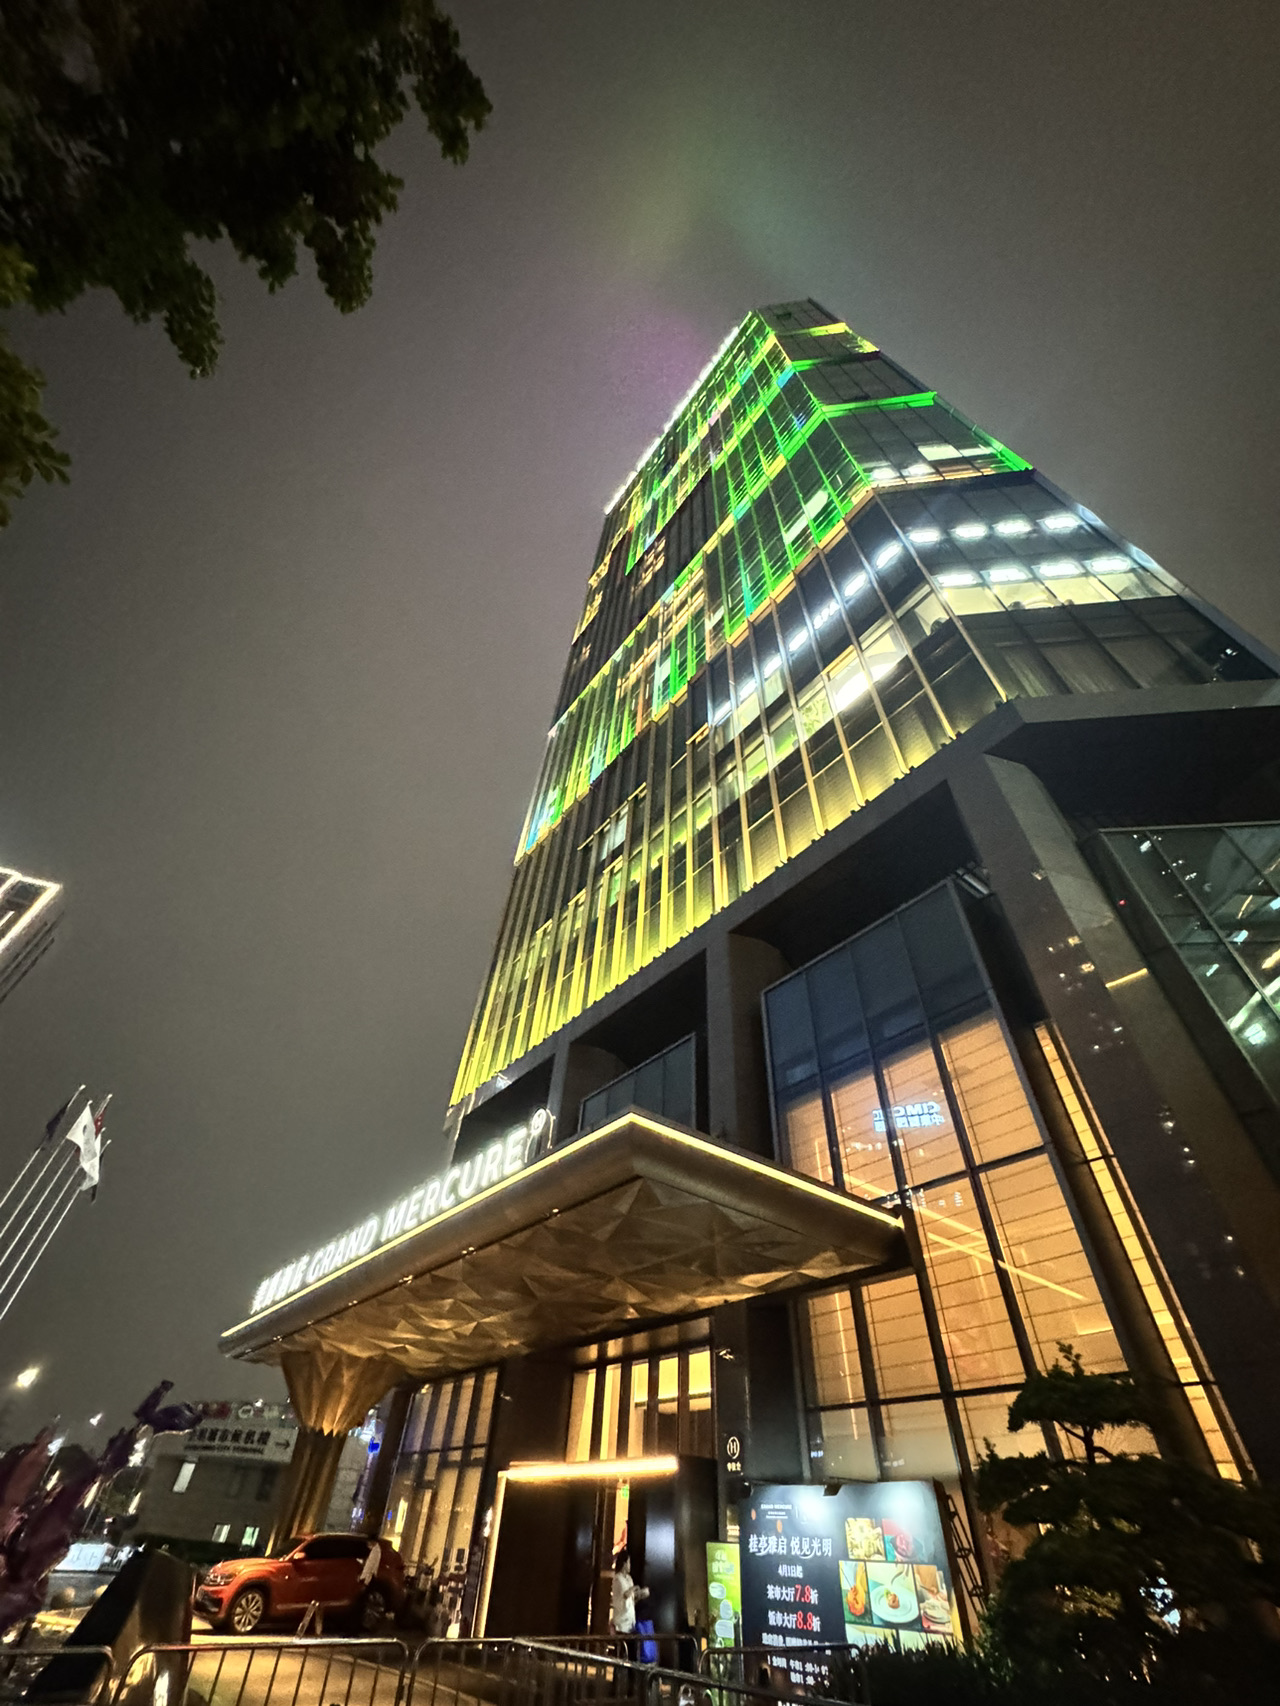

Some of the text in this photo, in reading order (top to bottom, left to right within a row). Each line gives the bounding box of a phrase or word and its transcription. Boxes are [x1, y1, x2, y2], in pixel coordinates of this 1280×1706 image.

[306, 1217, 378, 1283] GRAND
[380, 1127, 528, 1241] MERCURE
[790, 1537, 832, 1559] 悦见光明
[778, 1564, 803, 1579] 4月1日起
[766, 1584, 819, 1605] 茶市大厅7.8折
[768, 1610, 820, 1633] 饭市大厅8.8折
